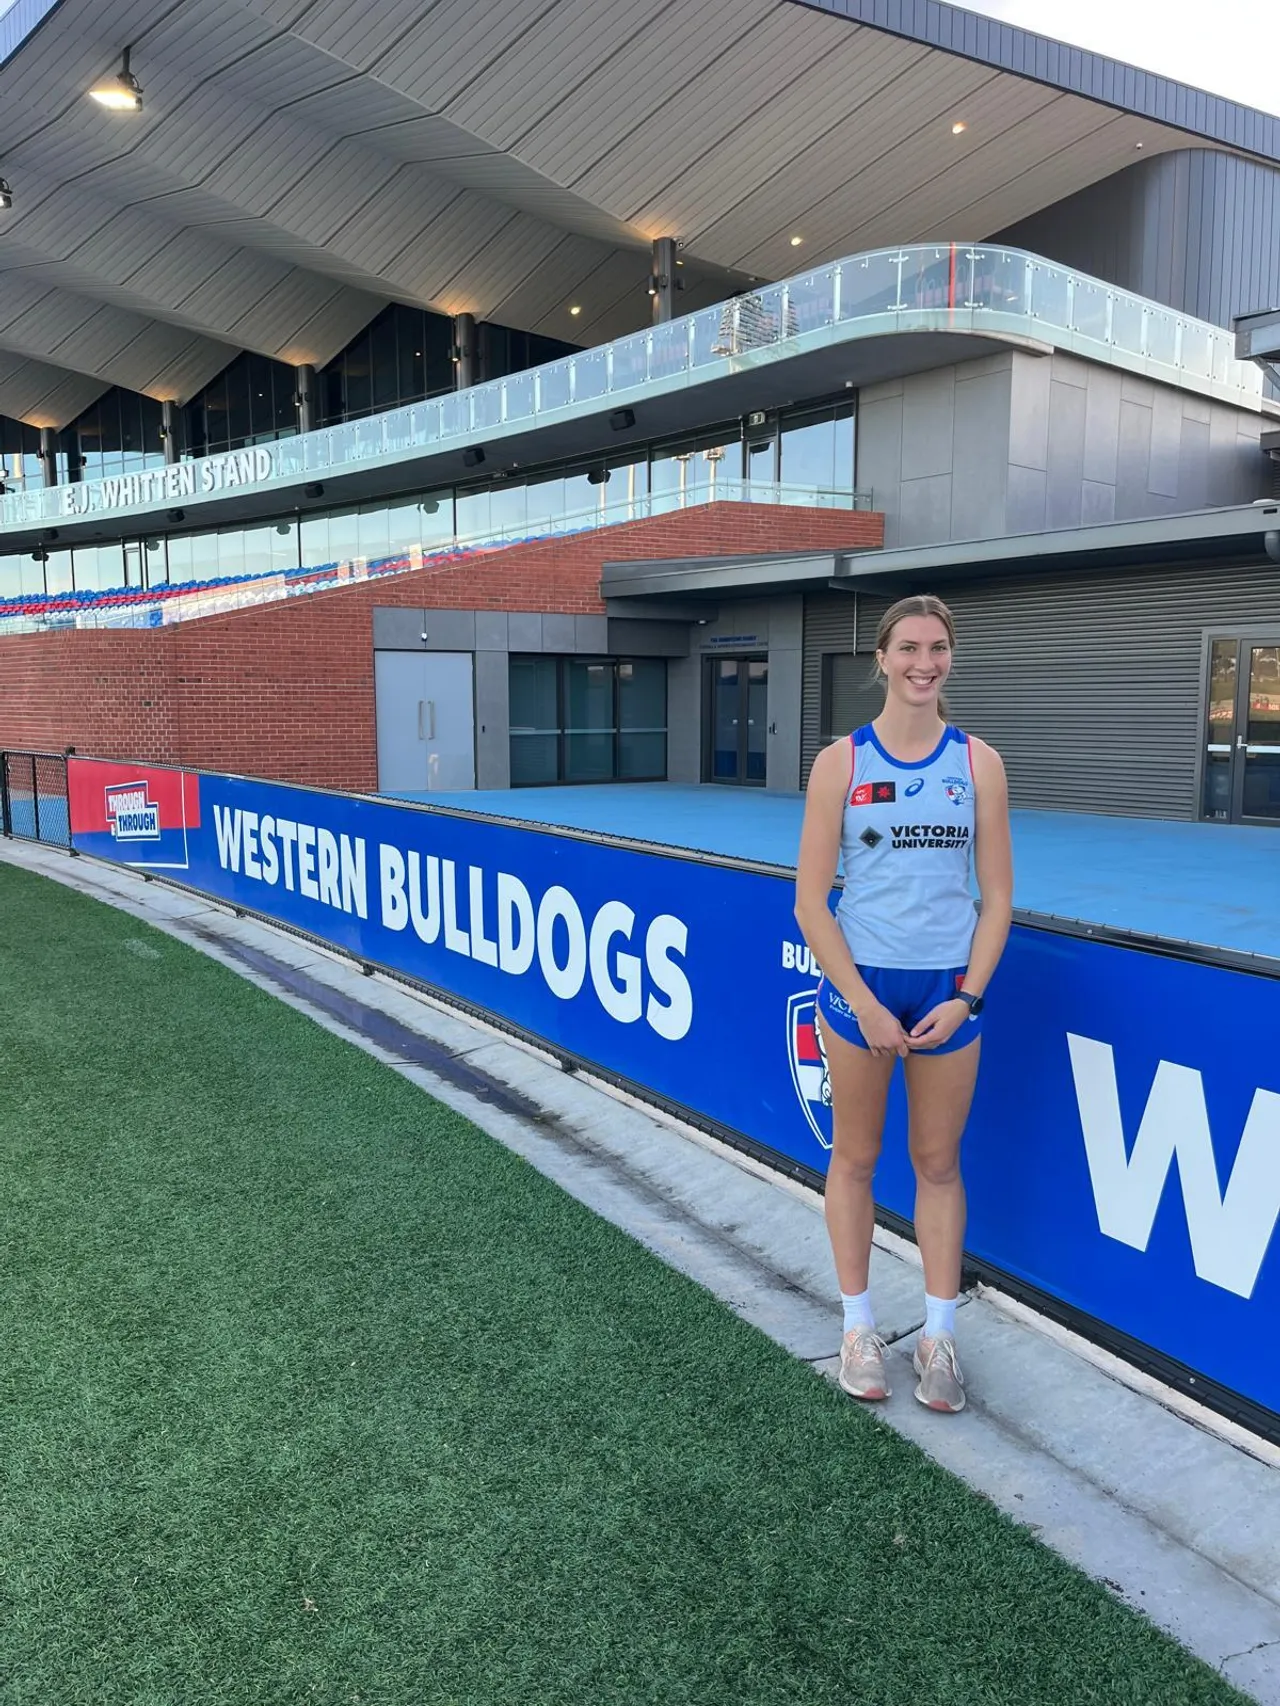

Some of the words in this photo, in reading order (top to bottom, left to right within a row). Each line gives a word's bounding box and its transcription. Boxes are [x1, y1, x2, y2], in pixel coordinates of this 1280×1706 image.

[63, 487, 95, 515] E.J.
[103, 467, 196, 509] WHITTEN
[202, 449, 272, 491] STAND
[118, 812, 156, 831] THROUGH
[890, 825, 969, 838] VICTORIA
[892, 838, 967, 849] UNIVERSITY
[213, 805, 368, 920] WESTERN
[380, 844, 694, 1041] BULLDOGS
[1066, 1032, 1280, 1300] W
